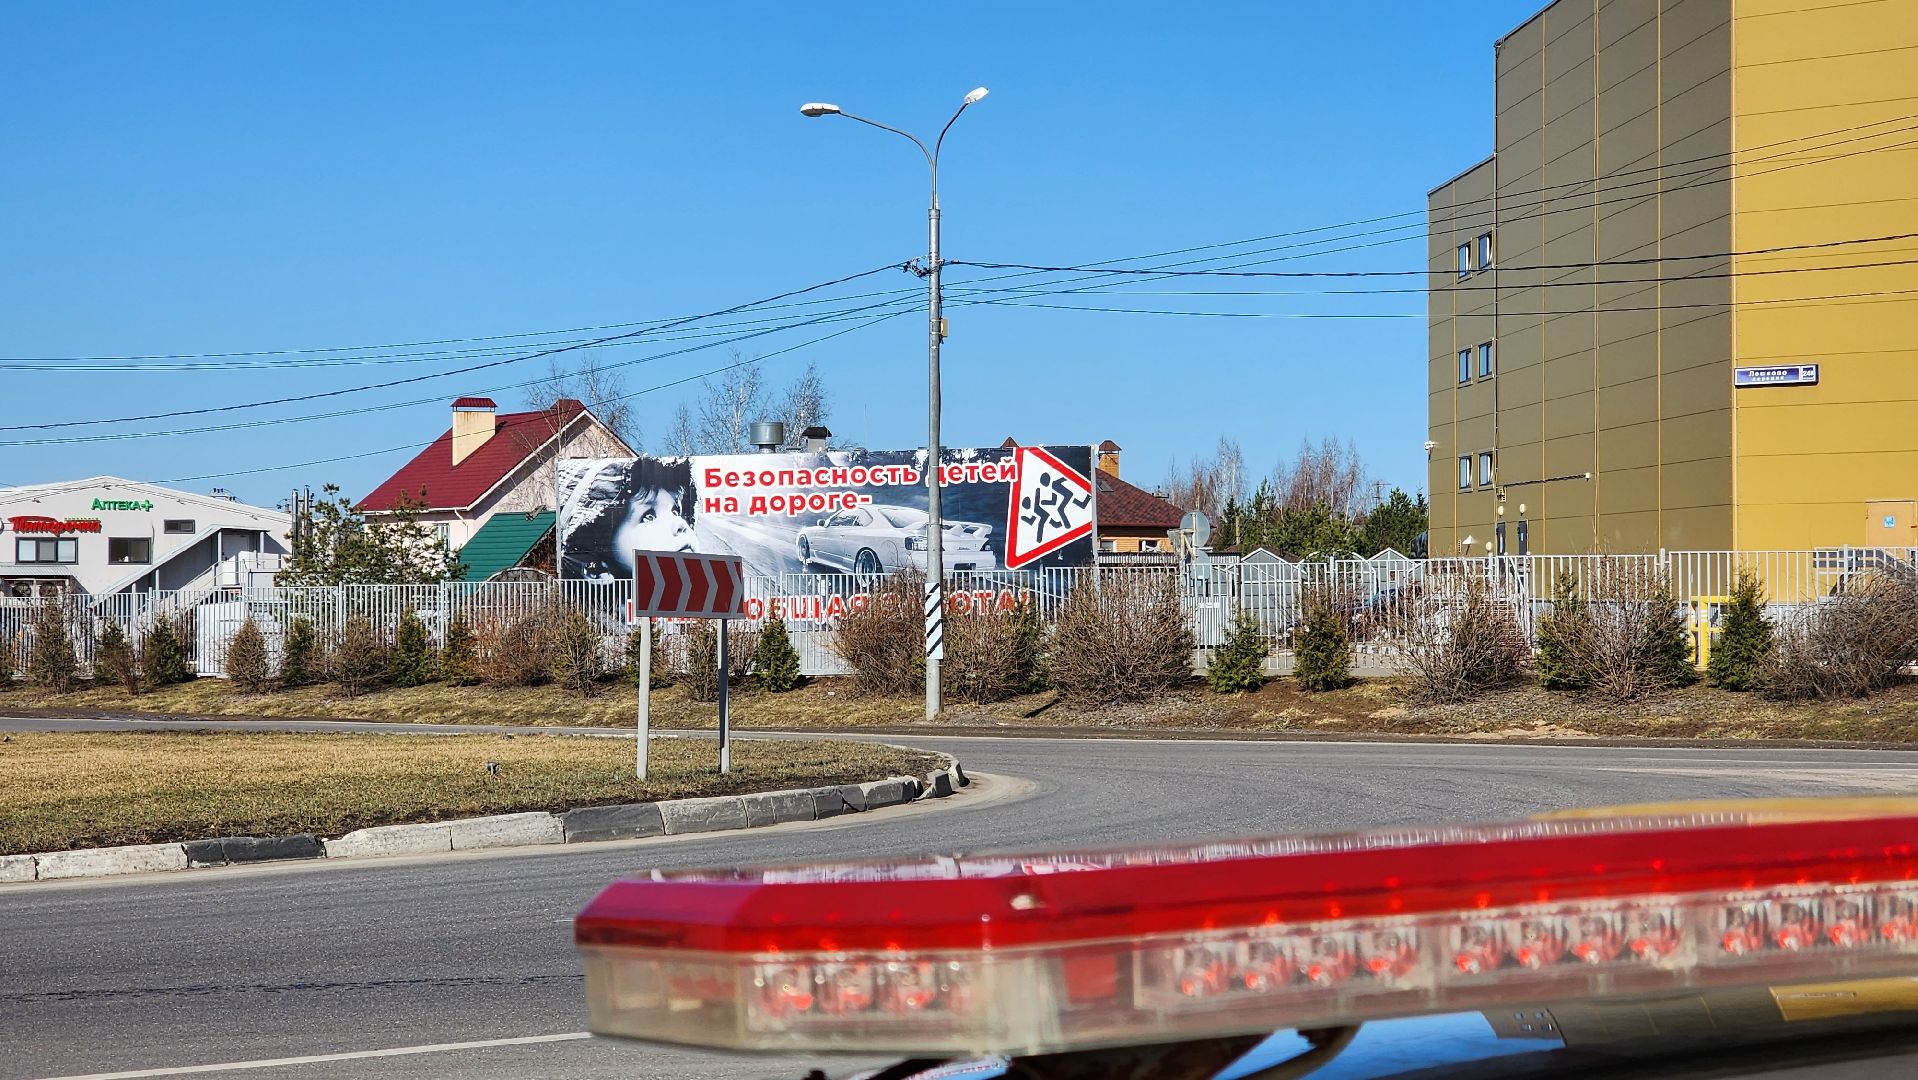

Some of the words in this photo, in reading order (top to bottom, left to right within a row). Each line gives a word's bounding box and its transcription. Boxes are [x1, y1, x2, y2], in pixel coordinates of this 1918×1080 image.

[704, 465, 918, 488] Безопасность
[704, 495, 739, 513] на
[749, 492, 871, 515] дороге-
